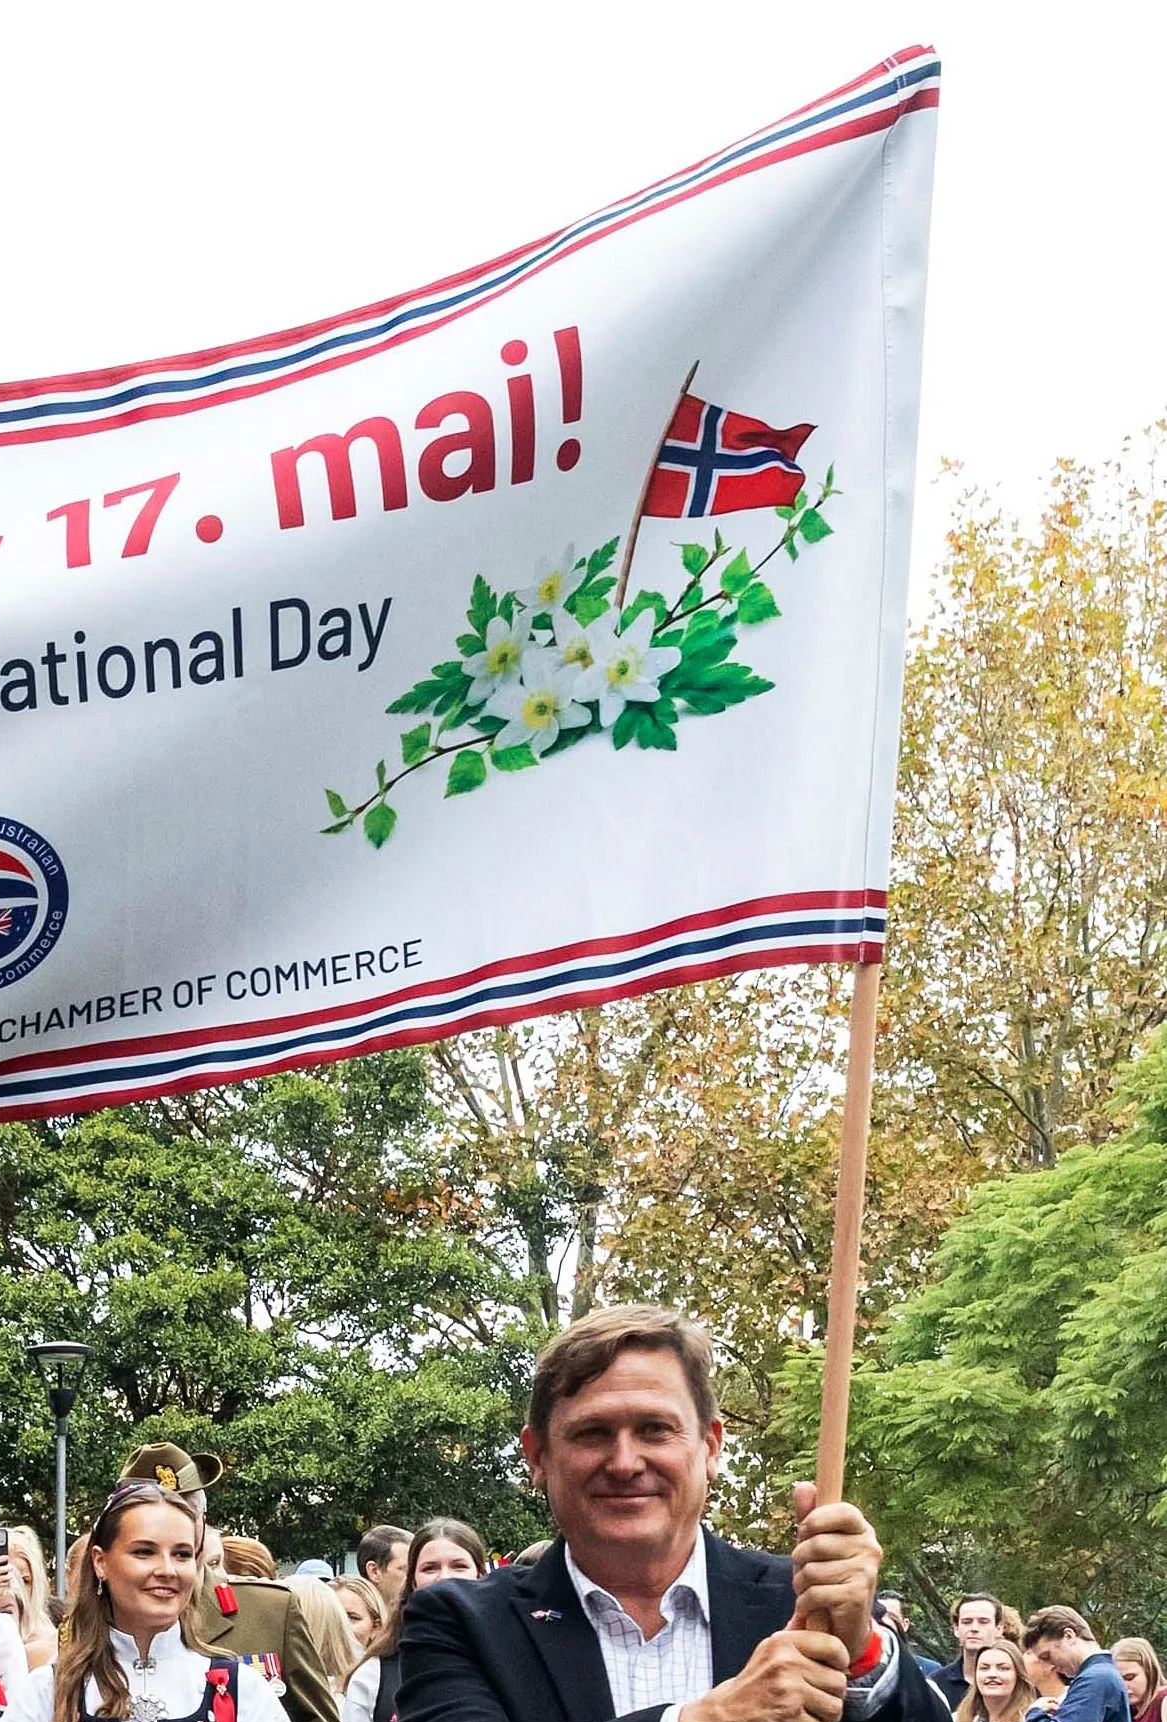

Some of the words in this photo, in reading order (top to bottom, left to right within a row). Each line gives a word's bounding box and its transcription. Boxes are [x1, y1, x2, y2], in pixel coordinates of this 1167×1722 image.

[46, 472, 224, 569] 17.
[270, 325, 584, 530] mai!
[268, 596, 393, 673] Day
[173, 974, 217, 1010] OF
[226, 939, 423, 1000] COMMERCE
